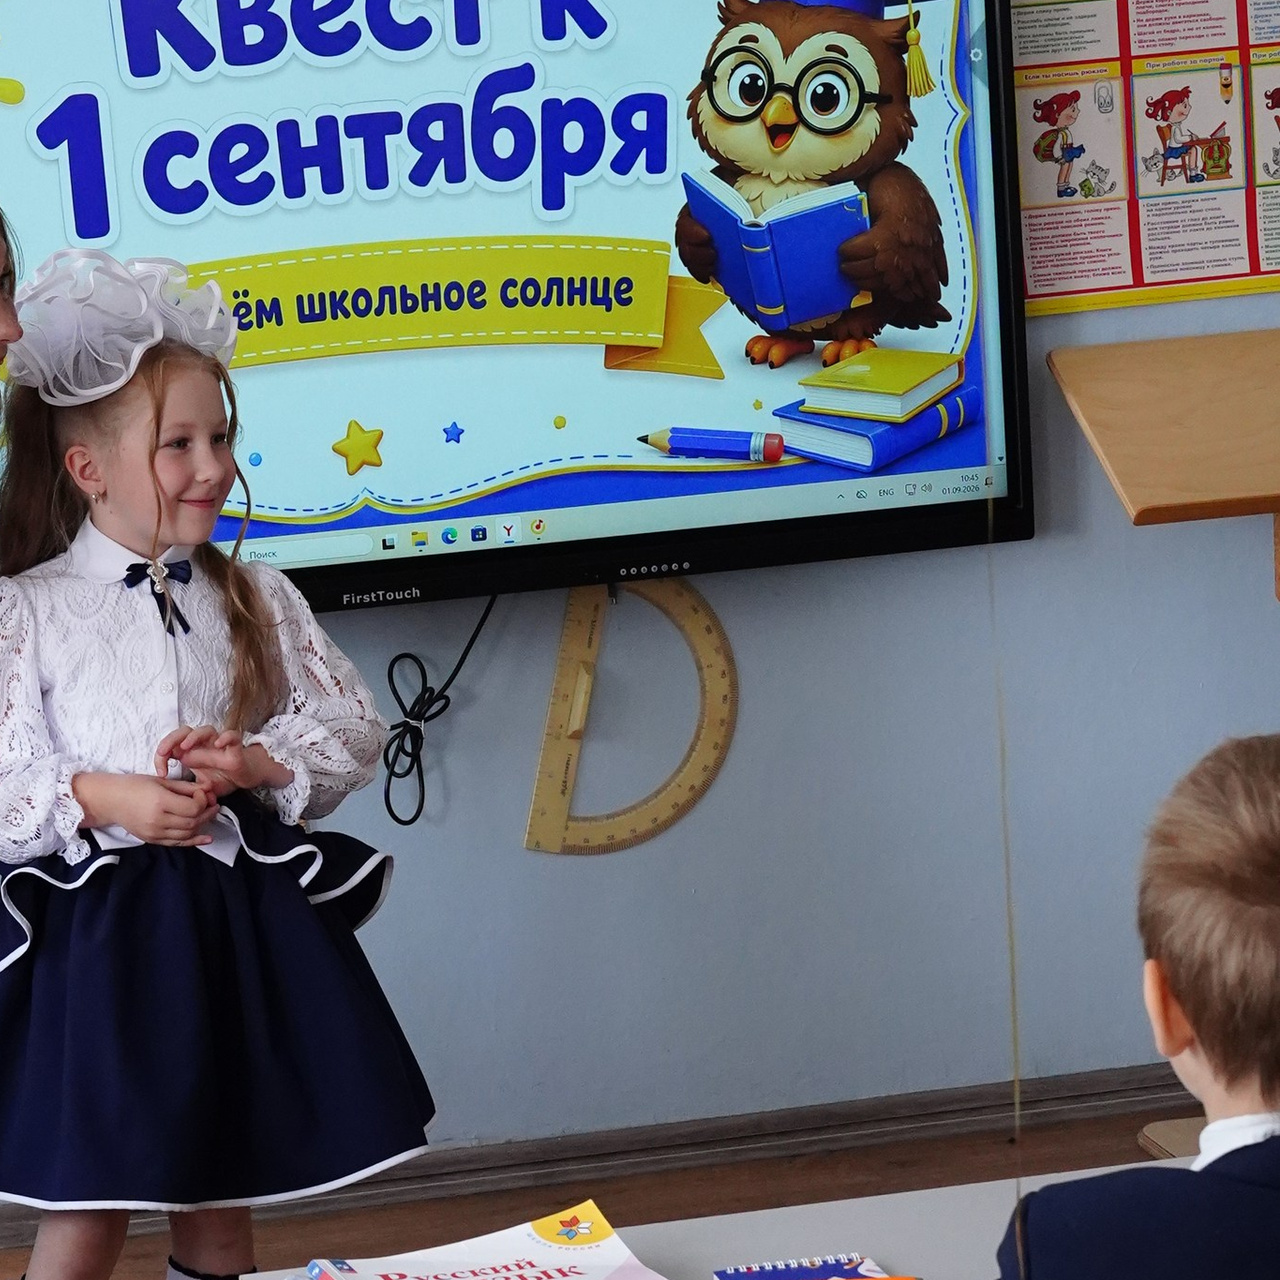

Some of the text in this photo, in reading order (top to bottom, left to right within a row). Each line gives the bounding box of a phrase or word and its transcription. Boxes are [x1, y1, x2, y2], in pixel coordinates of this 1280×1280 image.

[35, 61, 669, 240] 1 сентября
[297, 277, 488, 325] школьное
[500, 275, 634, 313] солнце
[960, 474, 979, 482] 10:45
[879, 488, 894, 497] ENG
[249, 550, 277, 560] Поиск
[343, 587, 421, 604] FirstTouch
